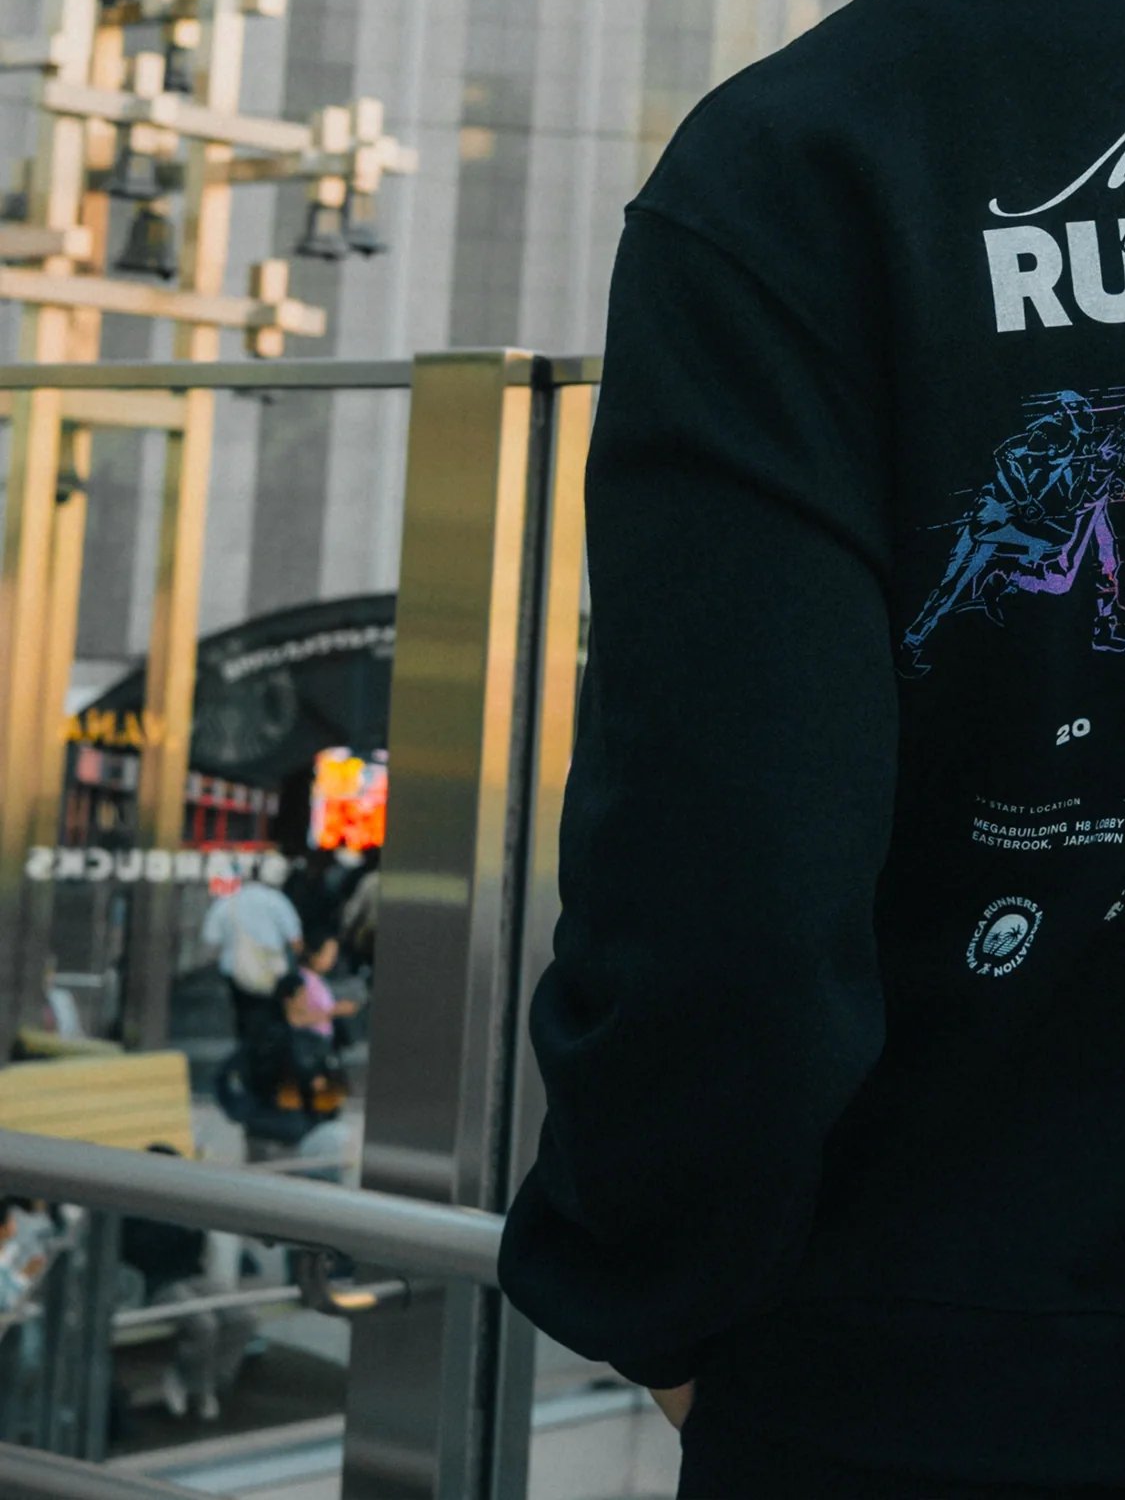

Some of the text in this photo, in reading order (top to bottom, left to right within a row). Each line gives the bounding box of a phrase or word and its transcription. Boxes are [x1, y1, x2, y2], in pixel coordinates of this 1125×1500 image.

[1056, 718, 1091, 745] 20
[990, 798, 1081, 814] START LOCATION
[973, 817, 1068, 838] MEGABUILDING
[983, 896, 1038, 919] RUNNERS
